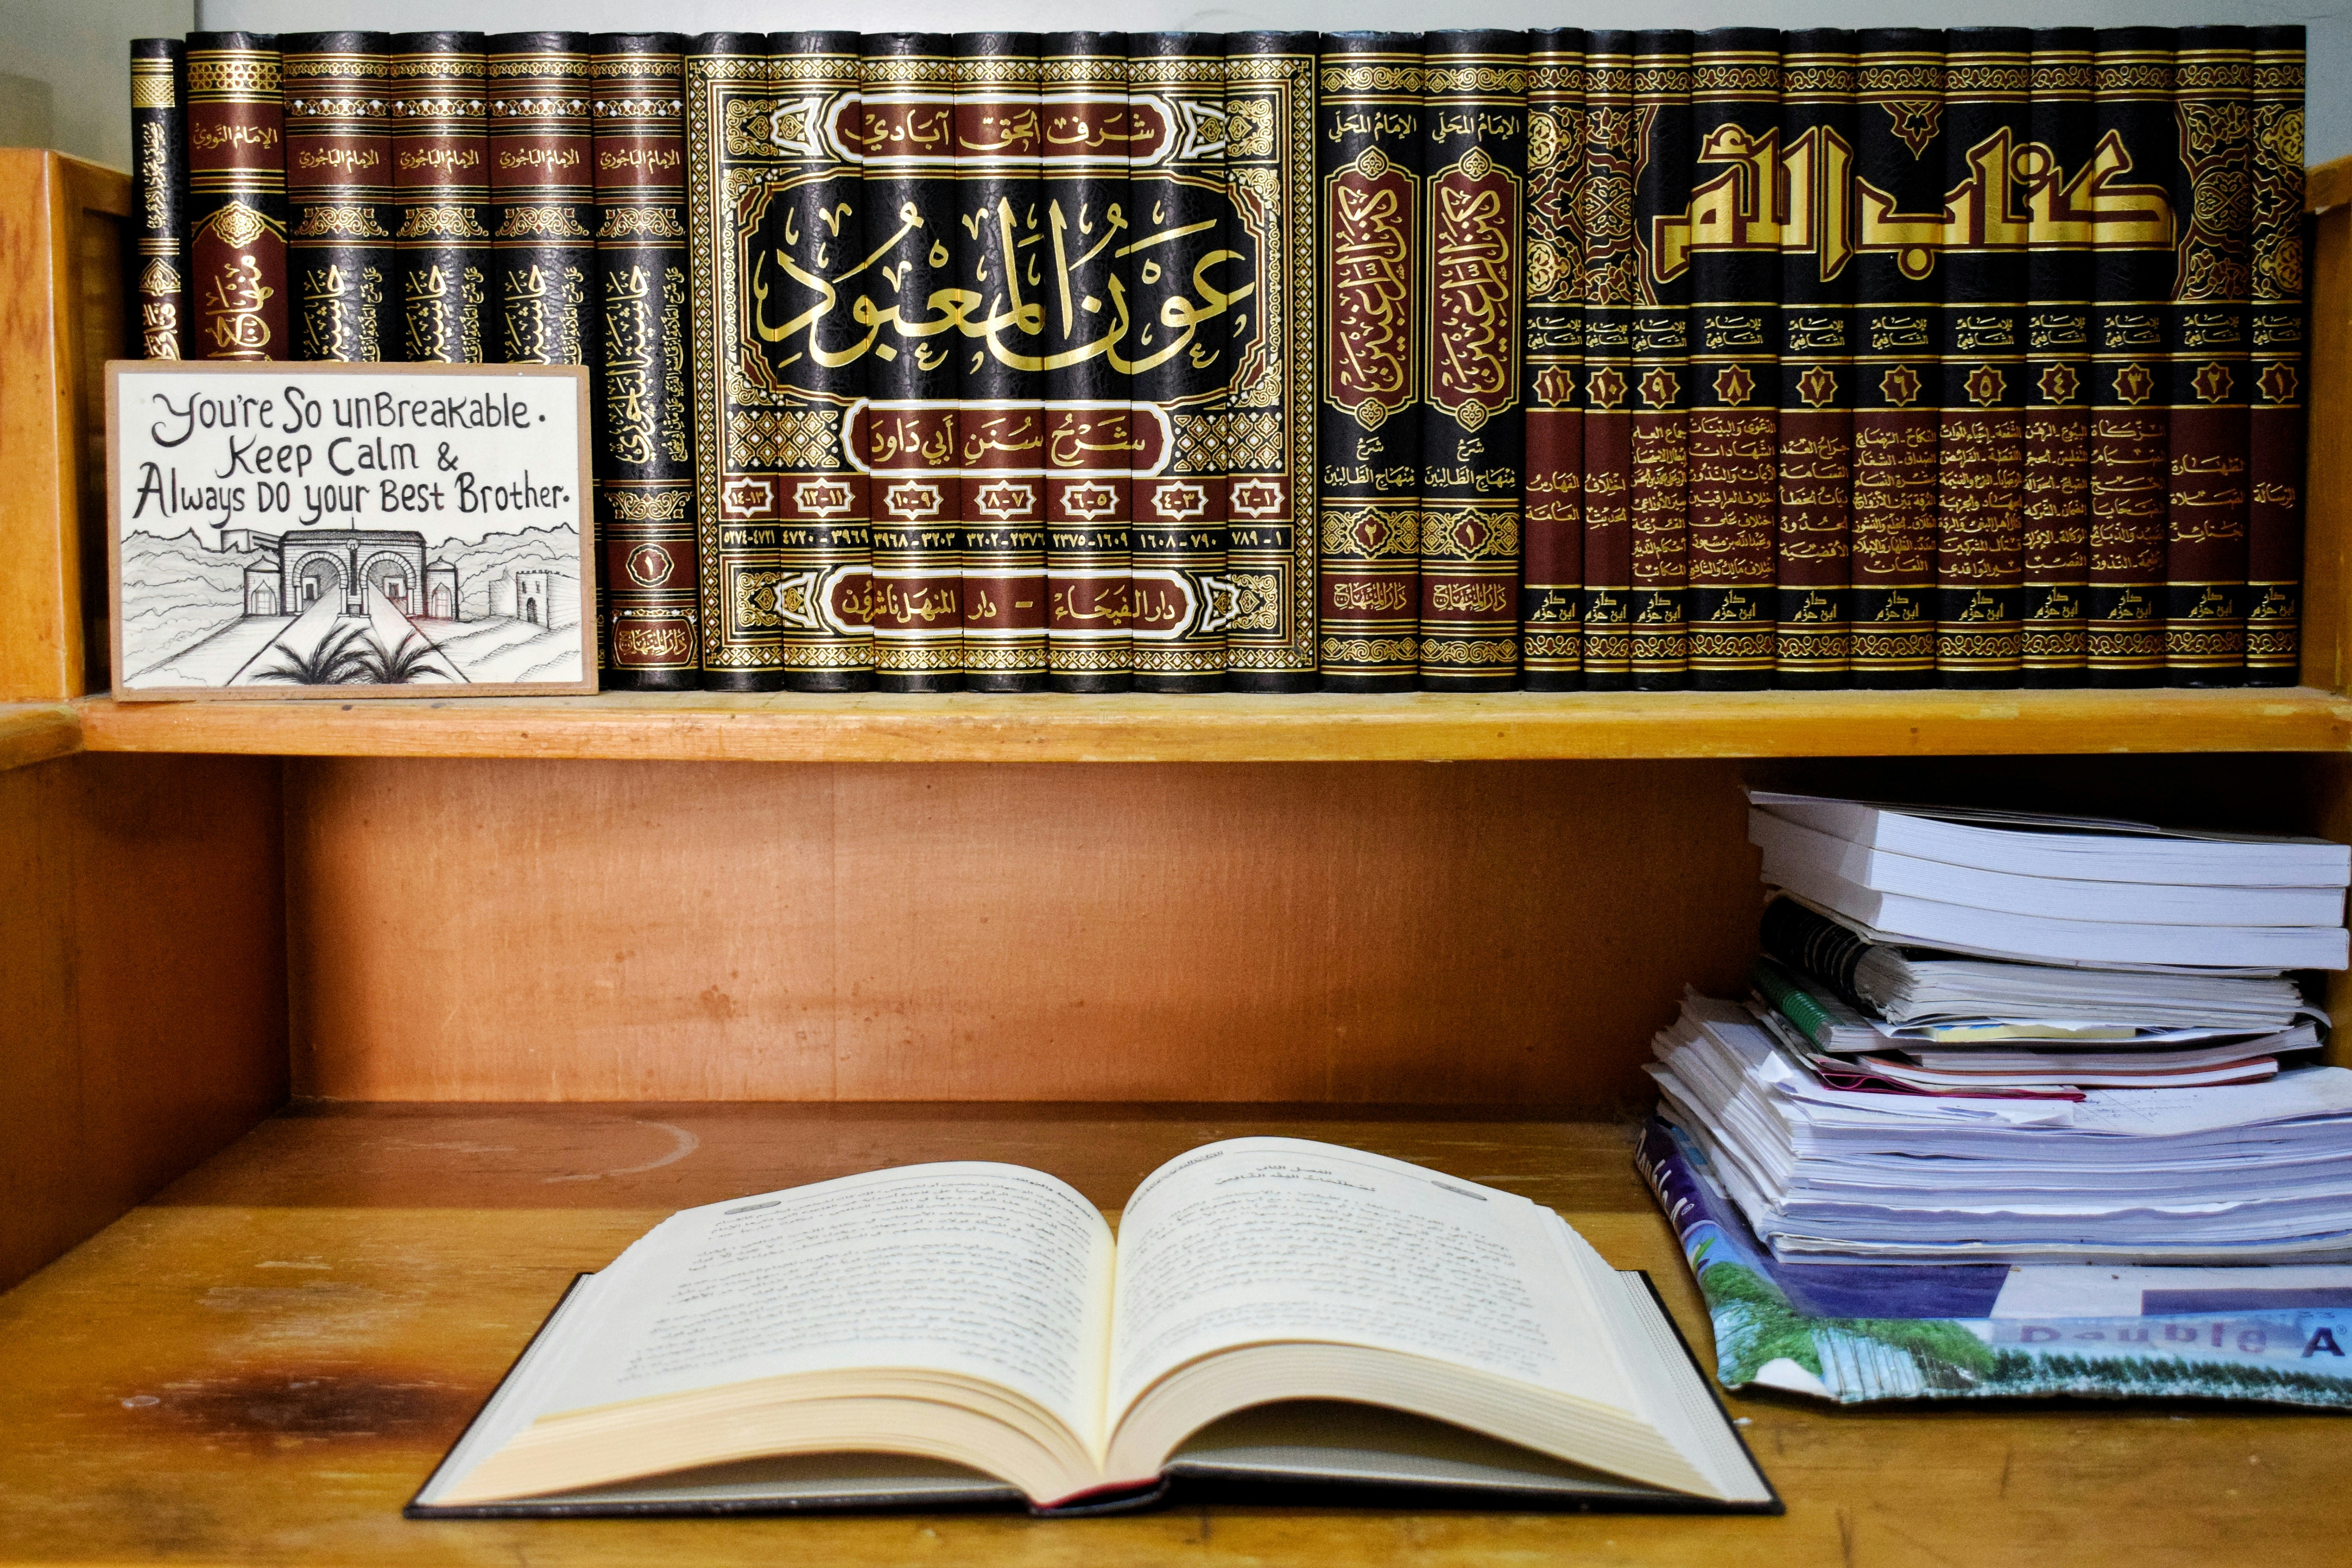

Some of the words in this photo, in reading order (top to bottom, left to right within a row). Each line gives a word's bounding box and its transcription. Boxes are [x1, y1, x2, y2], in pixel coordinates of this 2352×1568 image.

[151, 392, 273, 448] You're
[282, 386, 321, 434] So
[328, 436, 419, 476] Calm
[437, 441, 459, 472] &
[132, 459, 245, 530] Always
[299, 485, 370, 526] your
[379, 479, 445, 513] Best
[454, 470, 570, 514] Brother.
